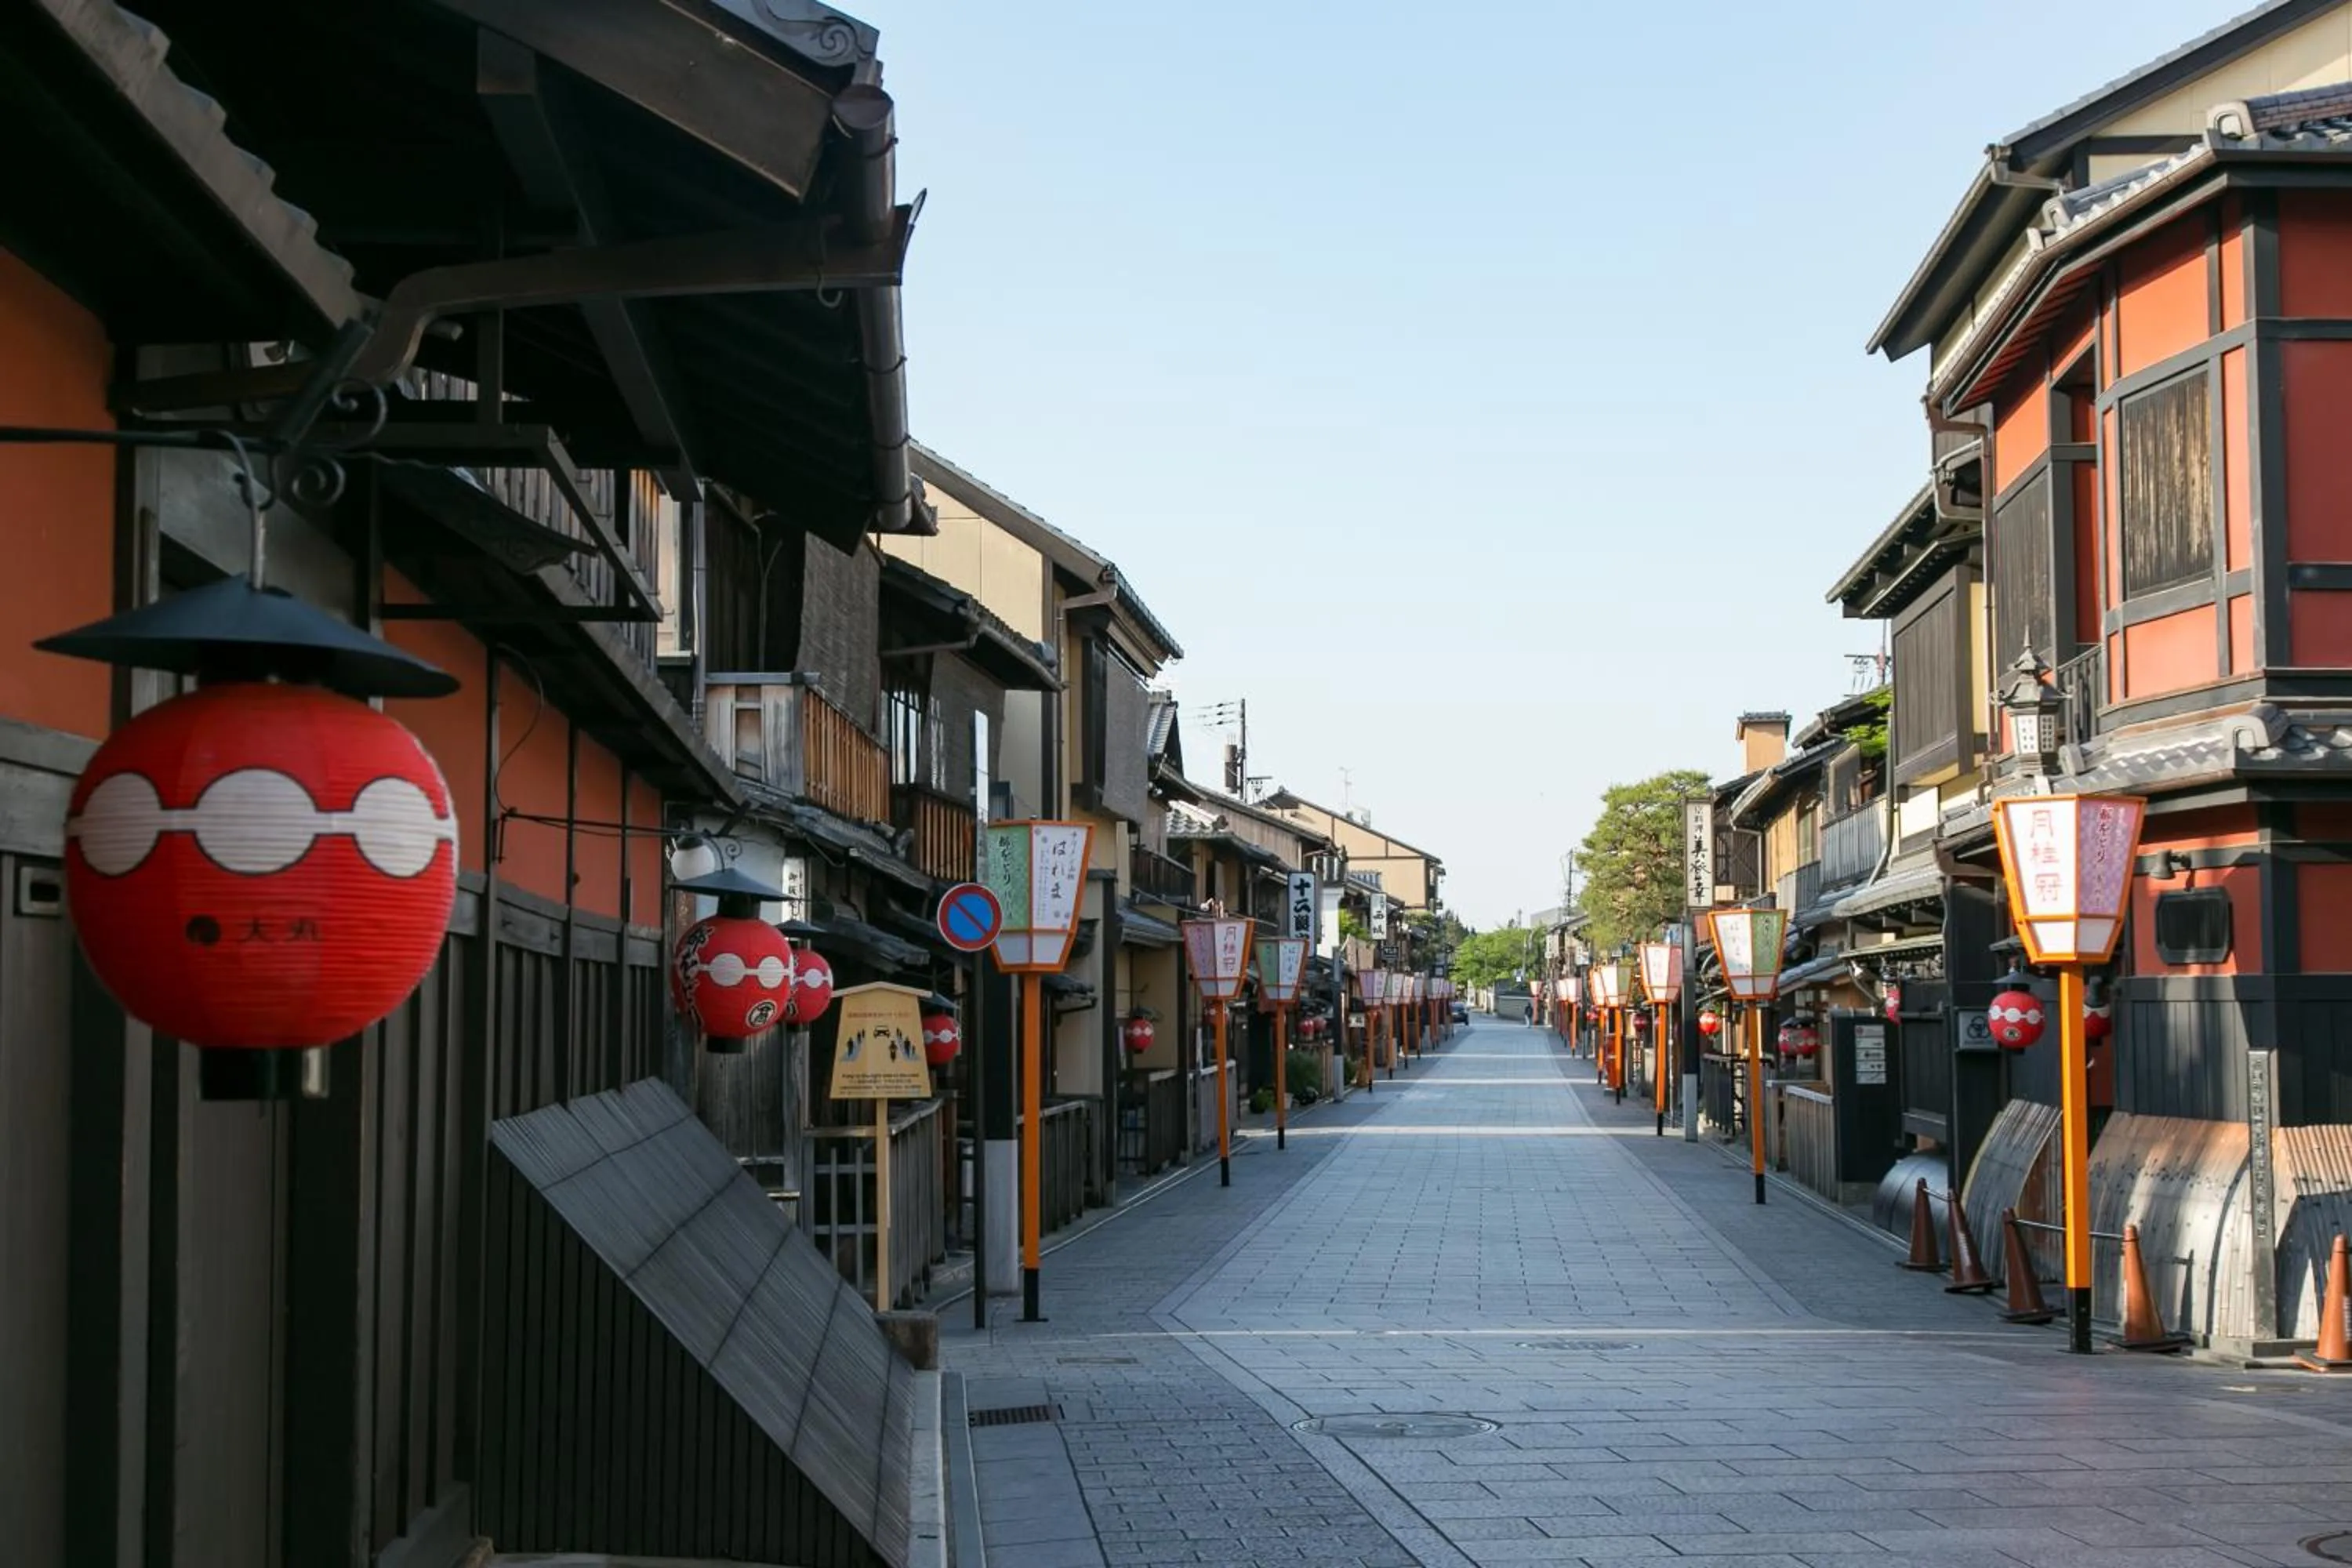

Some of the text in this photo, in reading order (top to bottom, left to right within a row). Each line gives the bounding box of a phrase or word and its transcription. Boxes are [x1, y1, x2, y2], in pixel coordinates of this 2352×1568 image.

[1051, 840, 1067, 900] はれま
[2030, 809, 2063, 902] 月桂冠
[236, 915, 322, 945] 大丸
